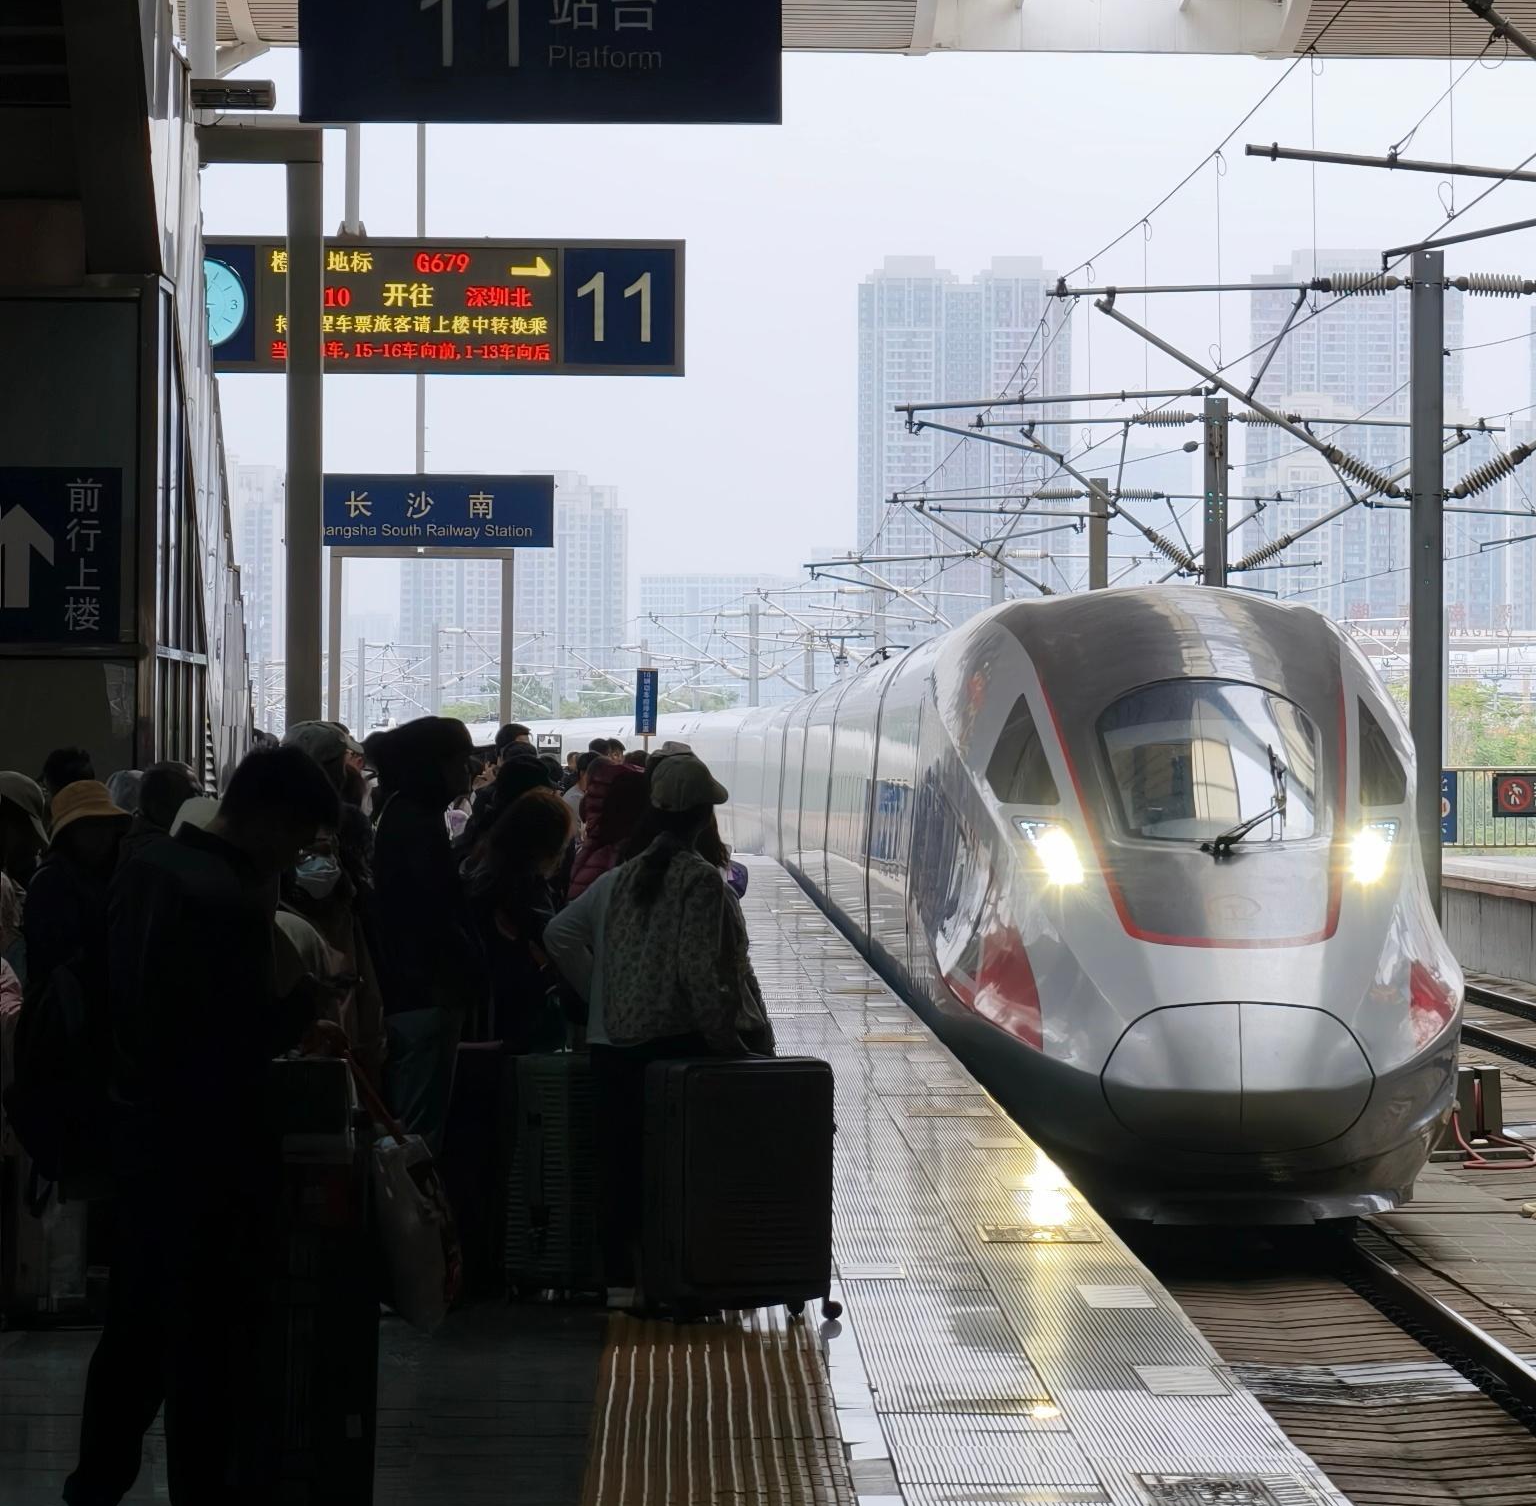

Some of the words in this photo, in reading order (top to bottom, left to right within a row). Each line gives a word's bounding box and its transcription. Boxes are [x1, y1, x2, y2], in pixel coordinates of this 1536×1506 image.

[549, 45, 662, 69] Platform
[416, 253, 470, 273] G679
[383, 282, 434, 308] 开往
[466, 286, 533, 308] 深圳北
[576, 271, 651, 343] 11
[344, 490, 495, 519] 长沙南
[323, 524, 376, 539] angsha
[381, 524, 422, 537] South
[426, 524, 480, 539] Railway
[484, 524, 533, 538] Station
[64, 477, 103, 631] 前行上楼
